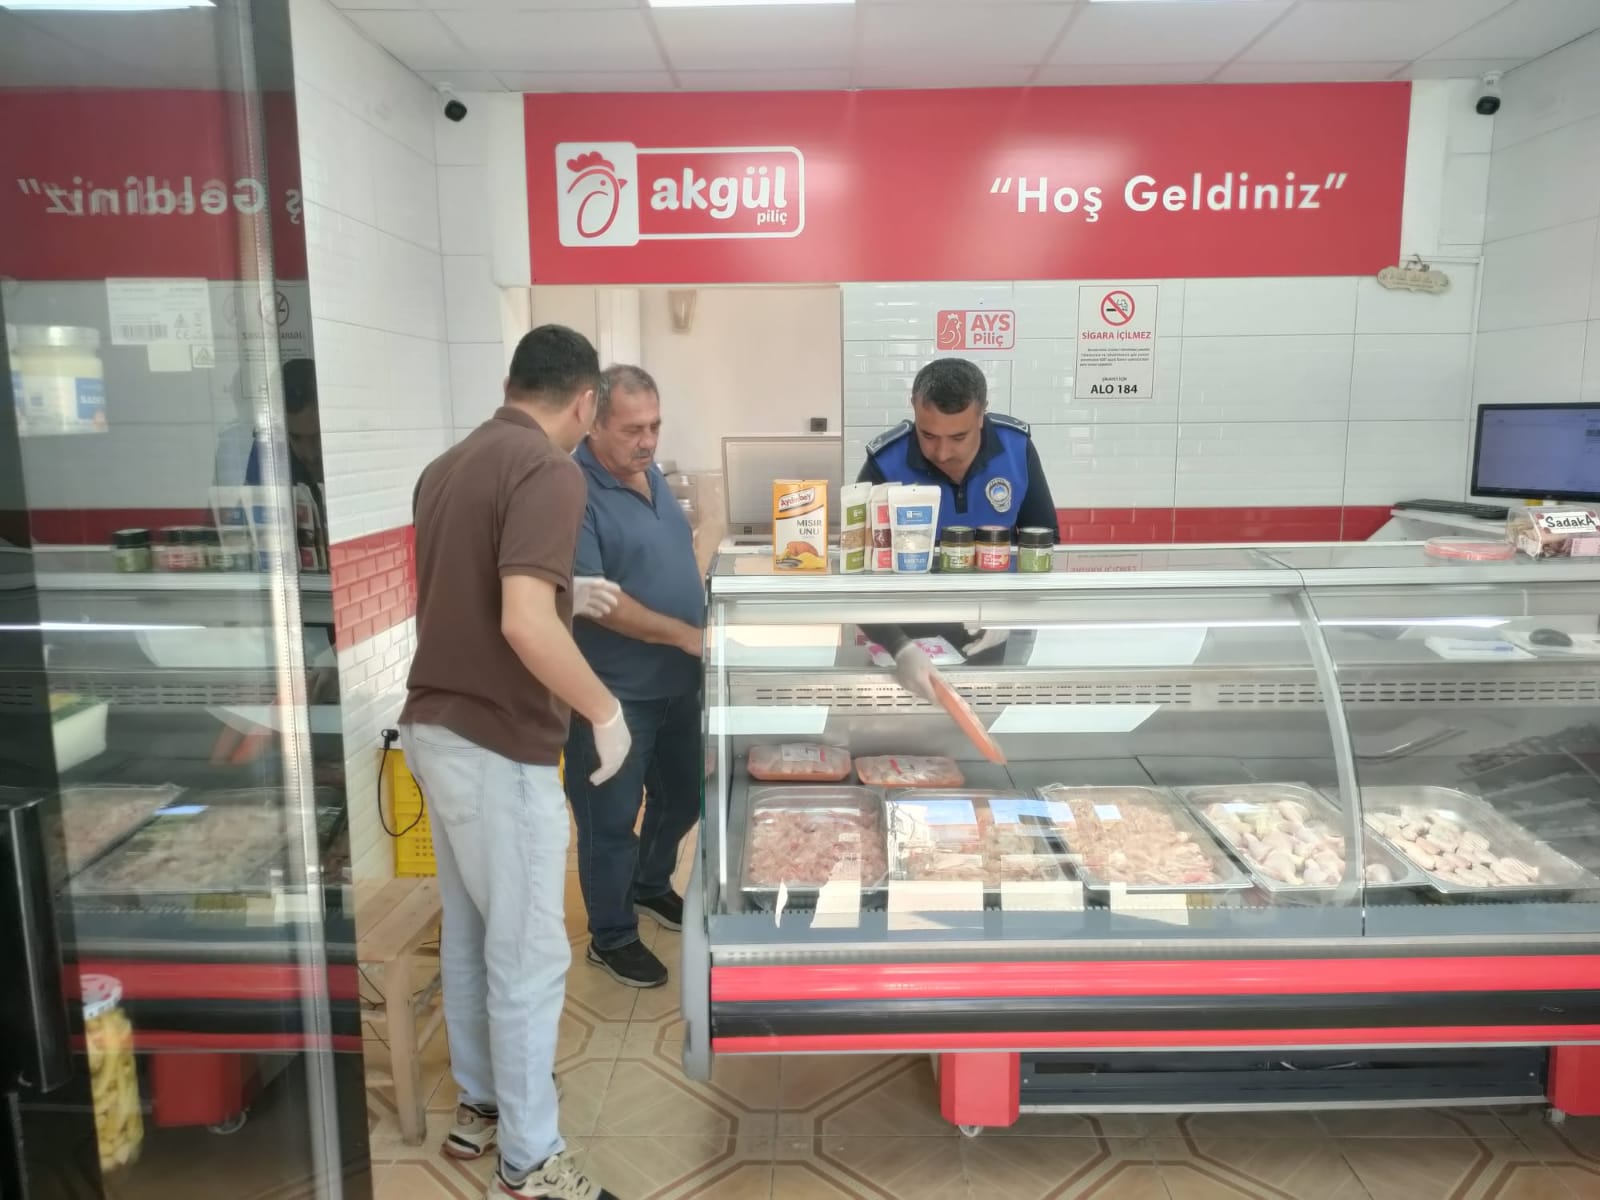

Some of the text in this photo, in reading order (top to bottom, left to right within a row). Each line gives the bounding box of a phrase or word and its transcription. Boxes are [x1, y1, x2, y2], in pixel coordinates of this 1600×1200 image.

[650, 166, 787, 219] akgül
[989, 172, 1349, 222] “Hoş Geldiniz”
[756, 210, 788, 225] piliç
[970, 313, 1011, 332] AYS
[973, 331, 1004, 348] Piliç
[1081, 329, 1152, 341] SİGARA İÇİLMEZ
[1090, 384, 1138, 394] ALO 184
